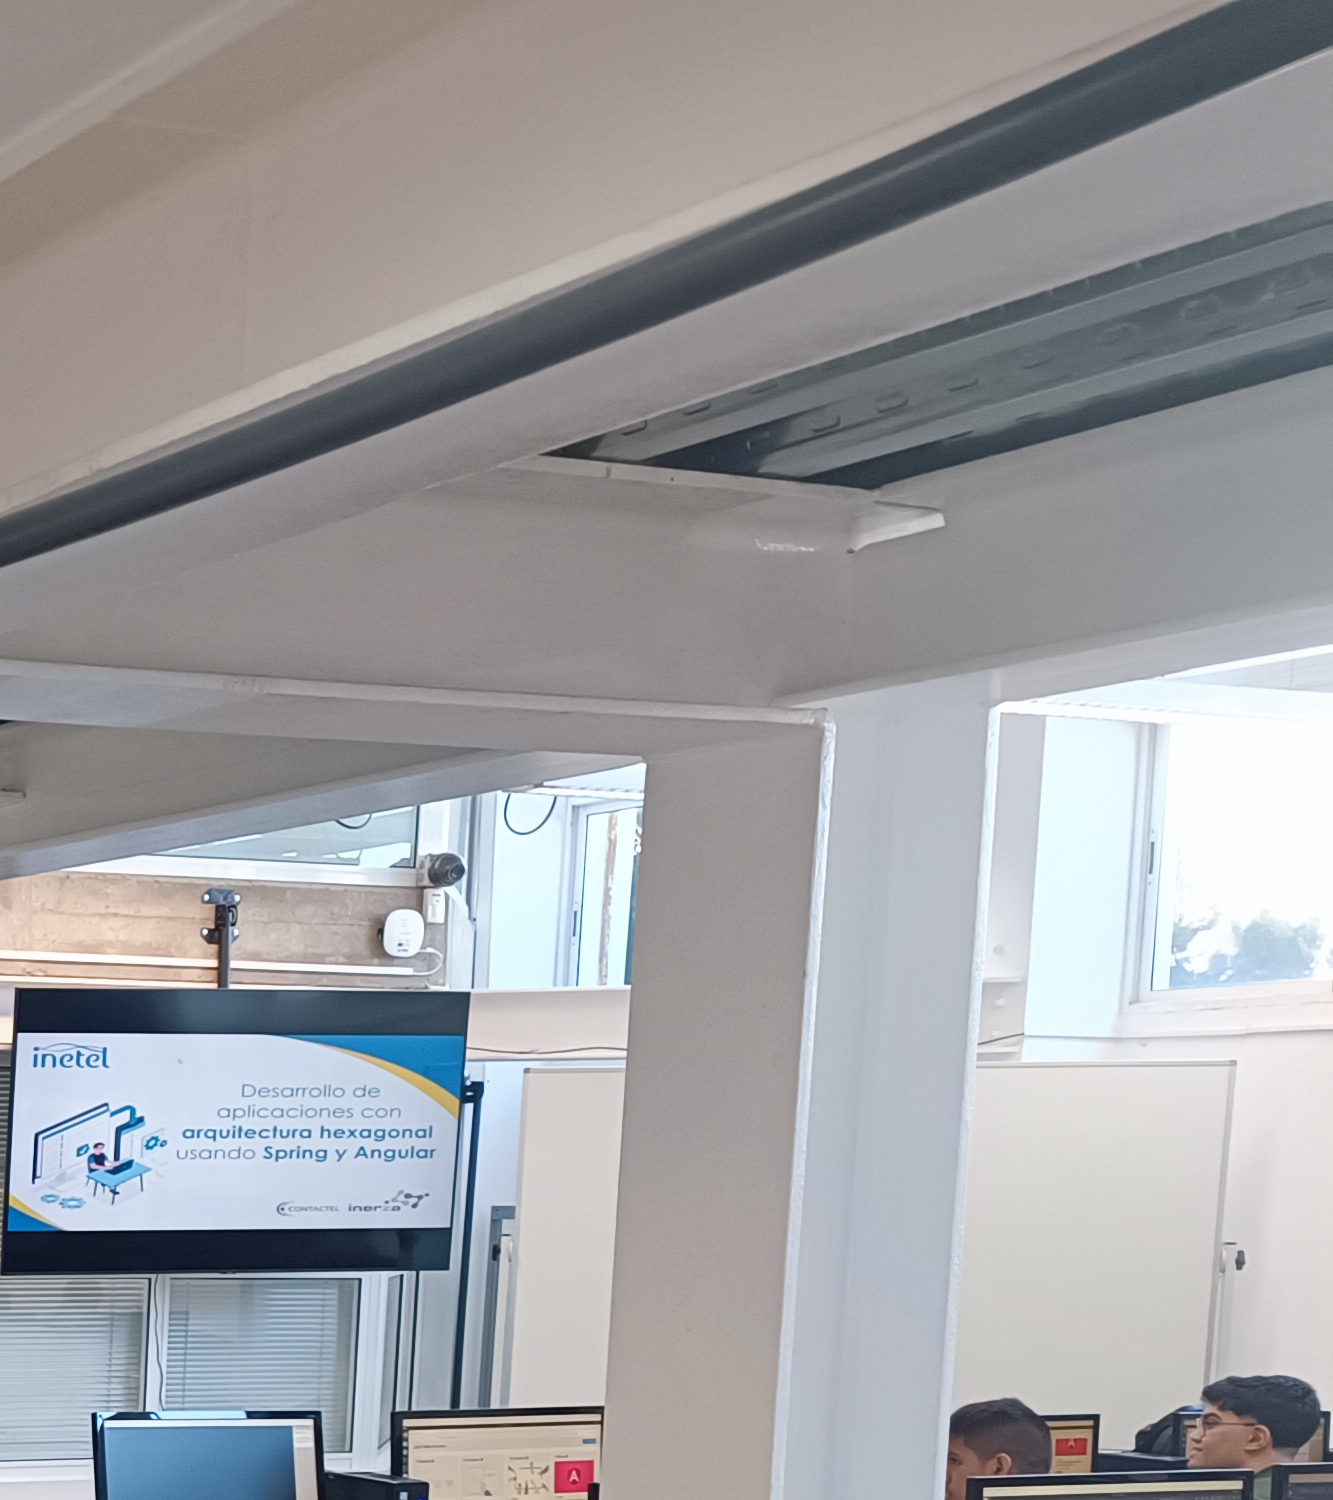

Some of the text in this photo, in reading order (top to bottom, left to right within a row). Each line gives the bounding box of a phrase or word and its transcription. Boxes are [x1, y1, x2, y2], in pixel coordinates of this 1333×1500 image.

[32, 1046, 111, 1069] inetel
[241, 1083, 381, 1099] Desarrollo de
[217, 1104, 402, 1121] aplicaciones con
[182, 1125, 433, 1142] arquitectura hexagonal
[176, 1146, 437, 1162] usando Spring y Angular
